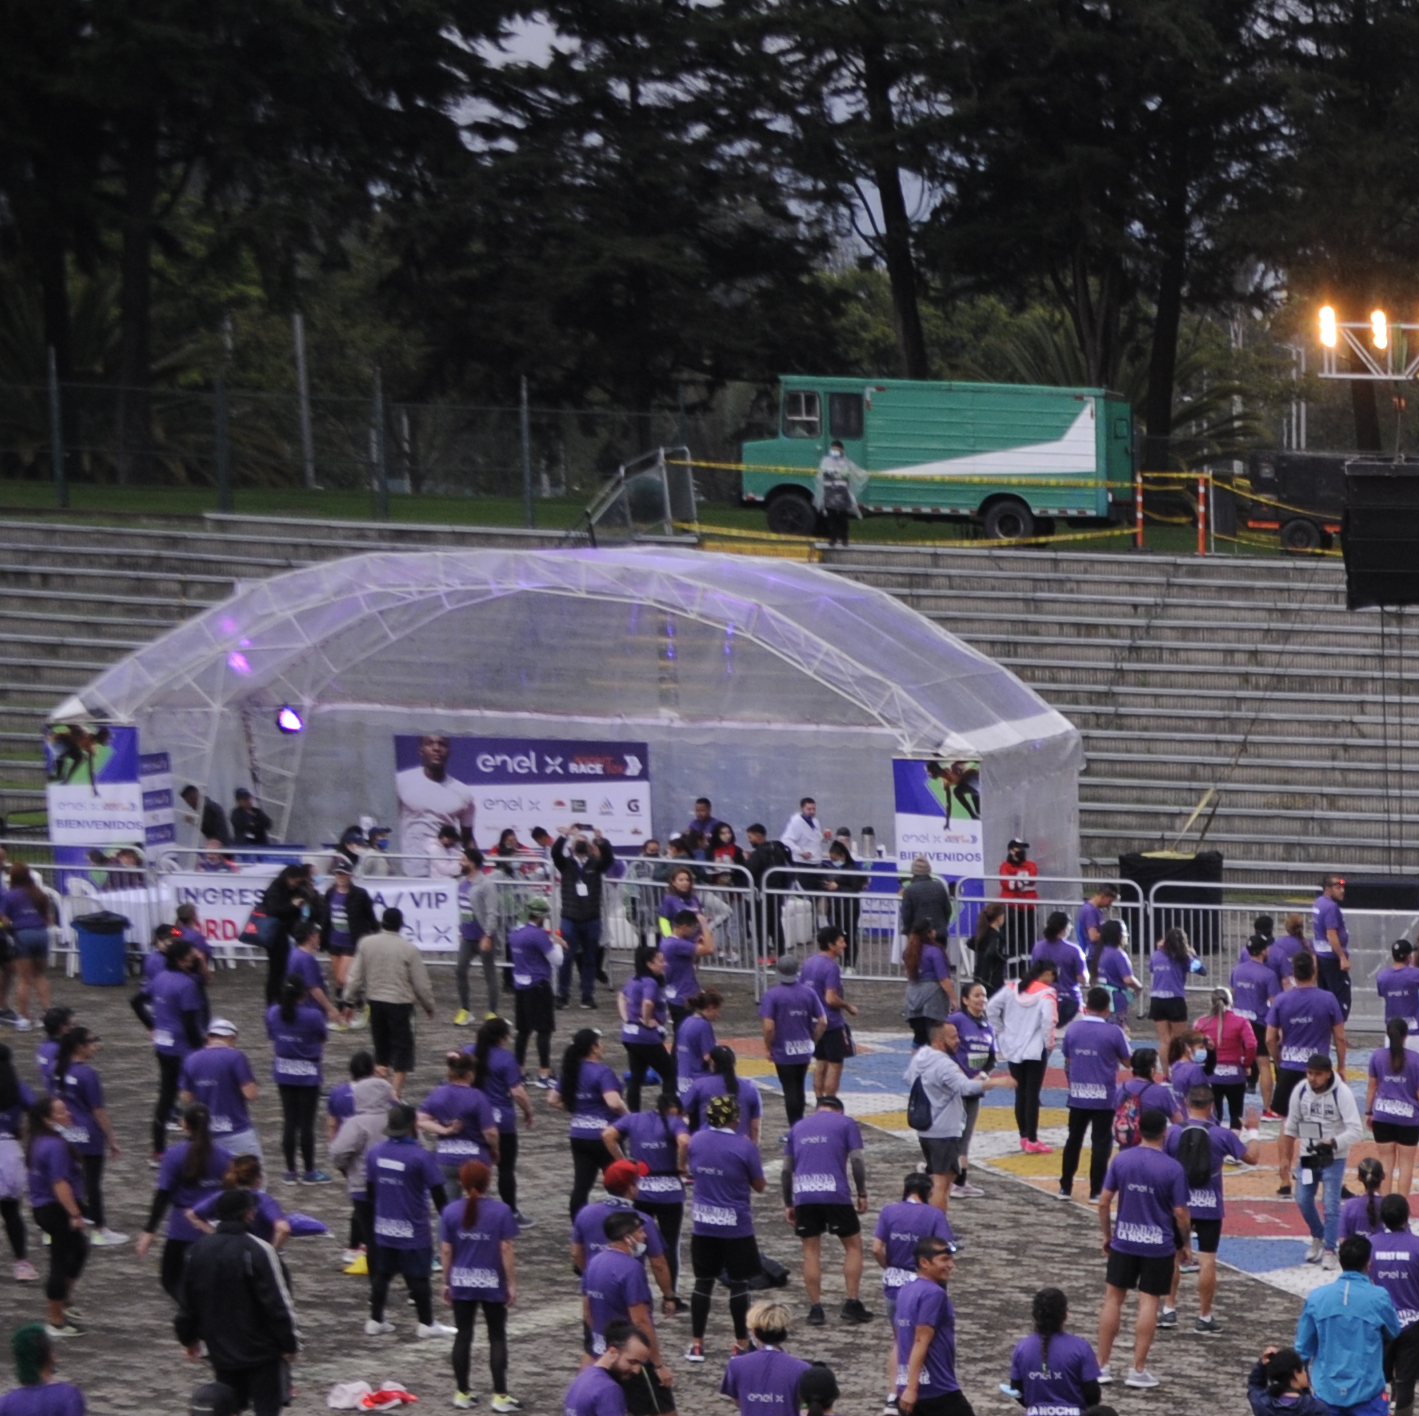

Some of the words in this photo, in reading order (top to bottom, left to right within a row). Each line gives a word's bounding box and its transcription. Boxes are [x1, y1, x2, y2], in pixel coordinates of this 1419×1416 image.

[476, 751, 538, 774] enel
[568, 763, 603, 774] RACE
[56, 819, 144, 830] BIENVENIDOS
[410, 892, 448, 909] VIP
